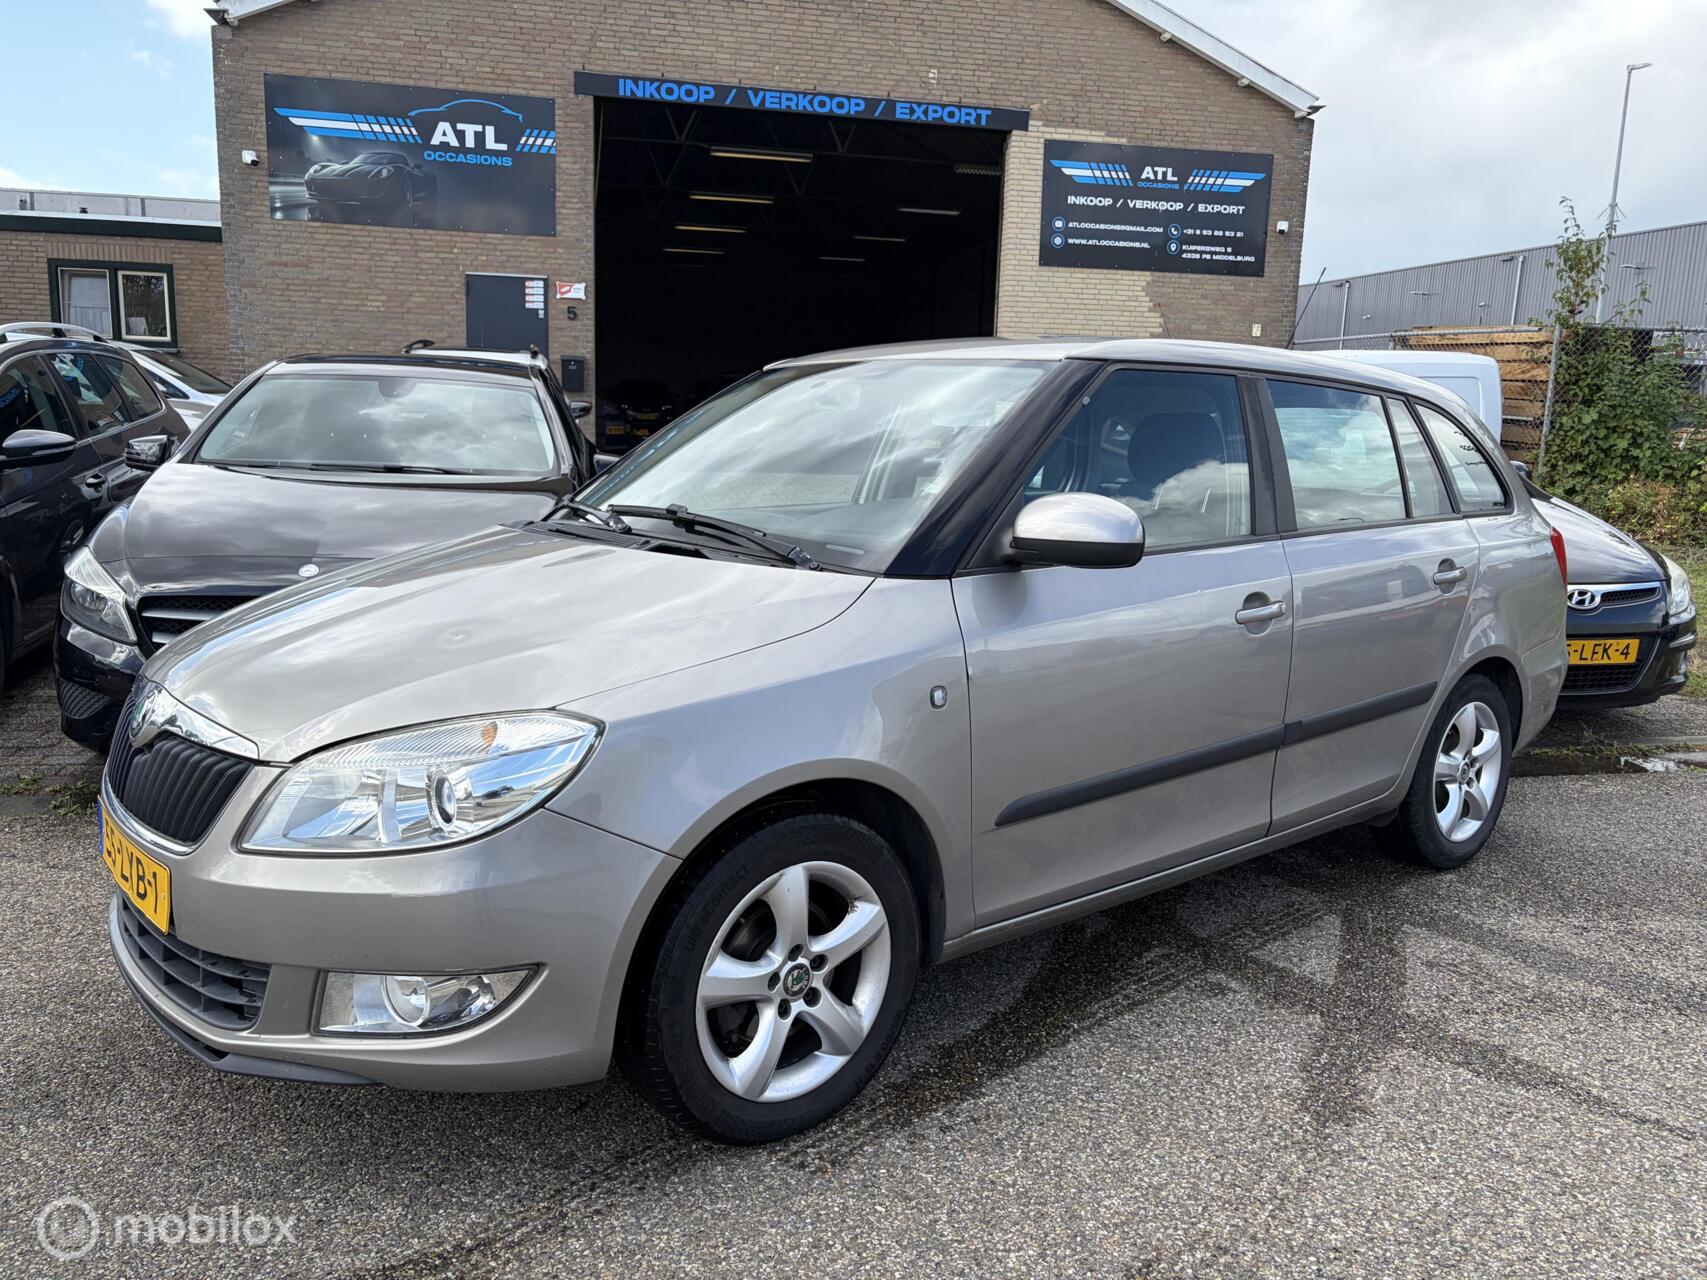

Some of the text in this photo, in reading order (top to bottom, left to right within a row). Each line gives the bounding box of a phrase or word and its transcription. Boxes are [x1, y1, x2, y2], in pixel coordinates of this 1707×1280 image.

[618, 78, 992, 127] INKOOP / VERKOOP / EXPORT
[430, 121, 508, 151] ATL
[423, 150, 513, 167] OCCASIONS
[1141, 166, 1178, 182] ATL
[1137, 181, 1180, 190] OCCASIONS
[1067, 195, 1246, 215] INKOOP / VERKOOP / EXPORT
[1067, 238, 1151, 248] WWW.ATLOCCASIONS.NL
[567, 306, 577, 320] 5
